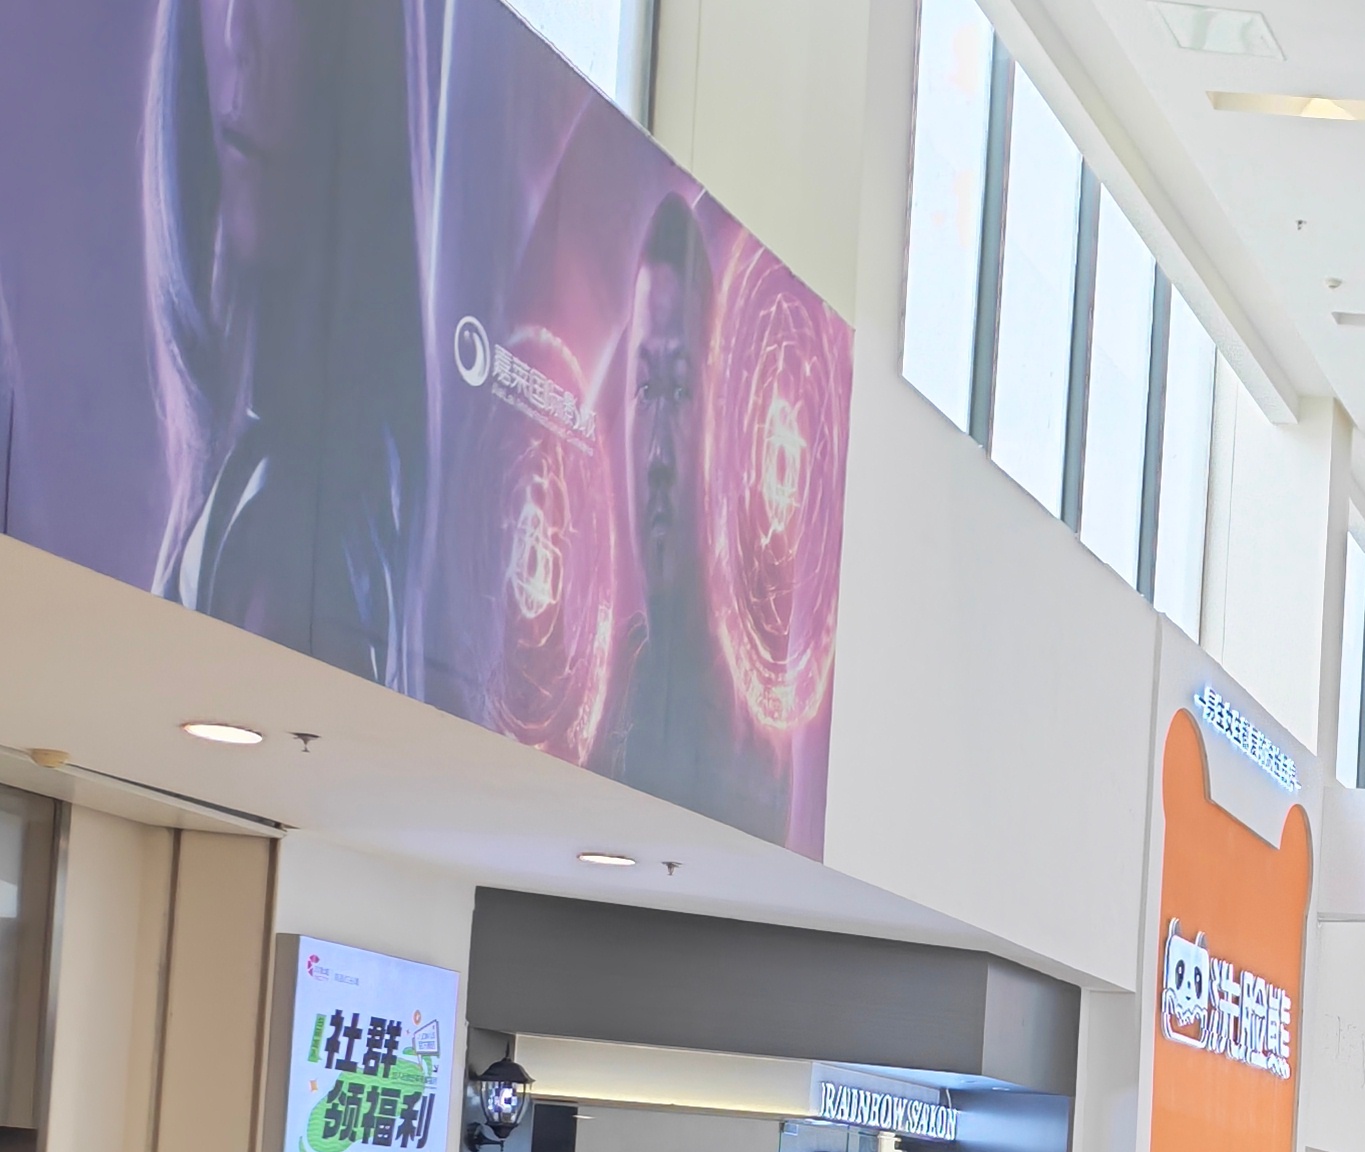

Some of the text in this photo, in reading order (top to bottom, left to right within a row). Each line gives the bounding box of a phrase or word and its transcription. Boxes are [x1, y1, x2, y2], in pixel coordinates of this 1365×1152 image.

[325, 1009, 402, 1079] 社群
[322, 1079, 436, 1149] 领福利
[820, 1081, 958, 1142] RAINBOW SALON
